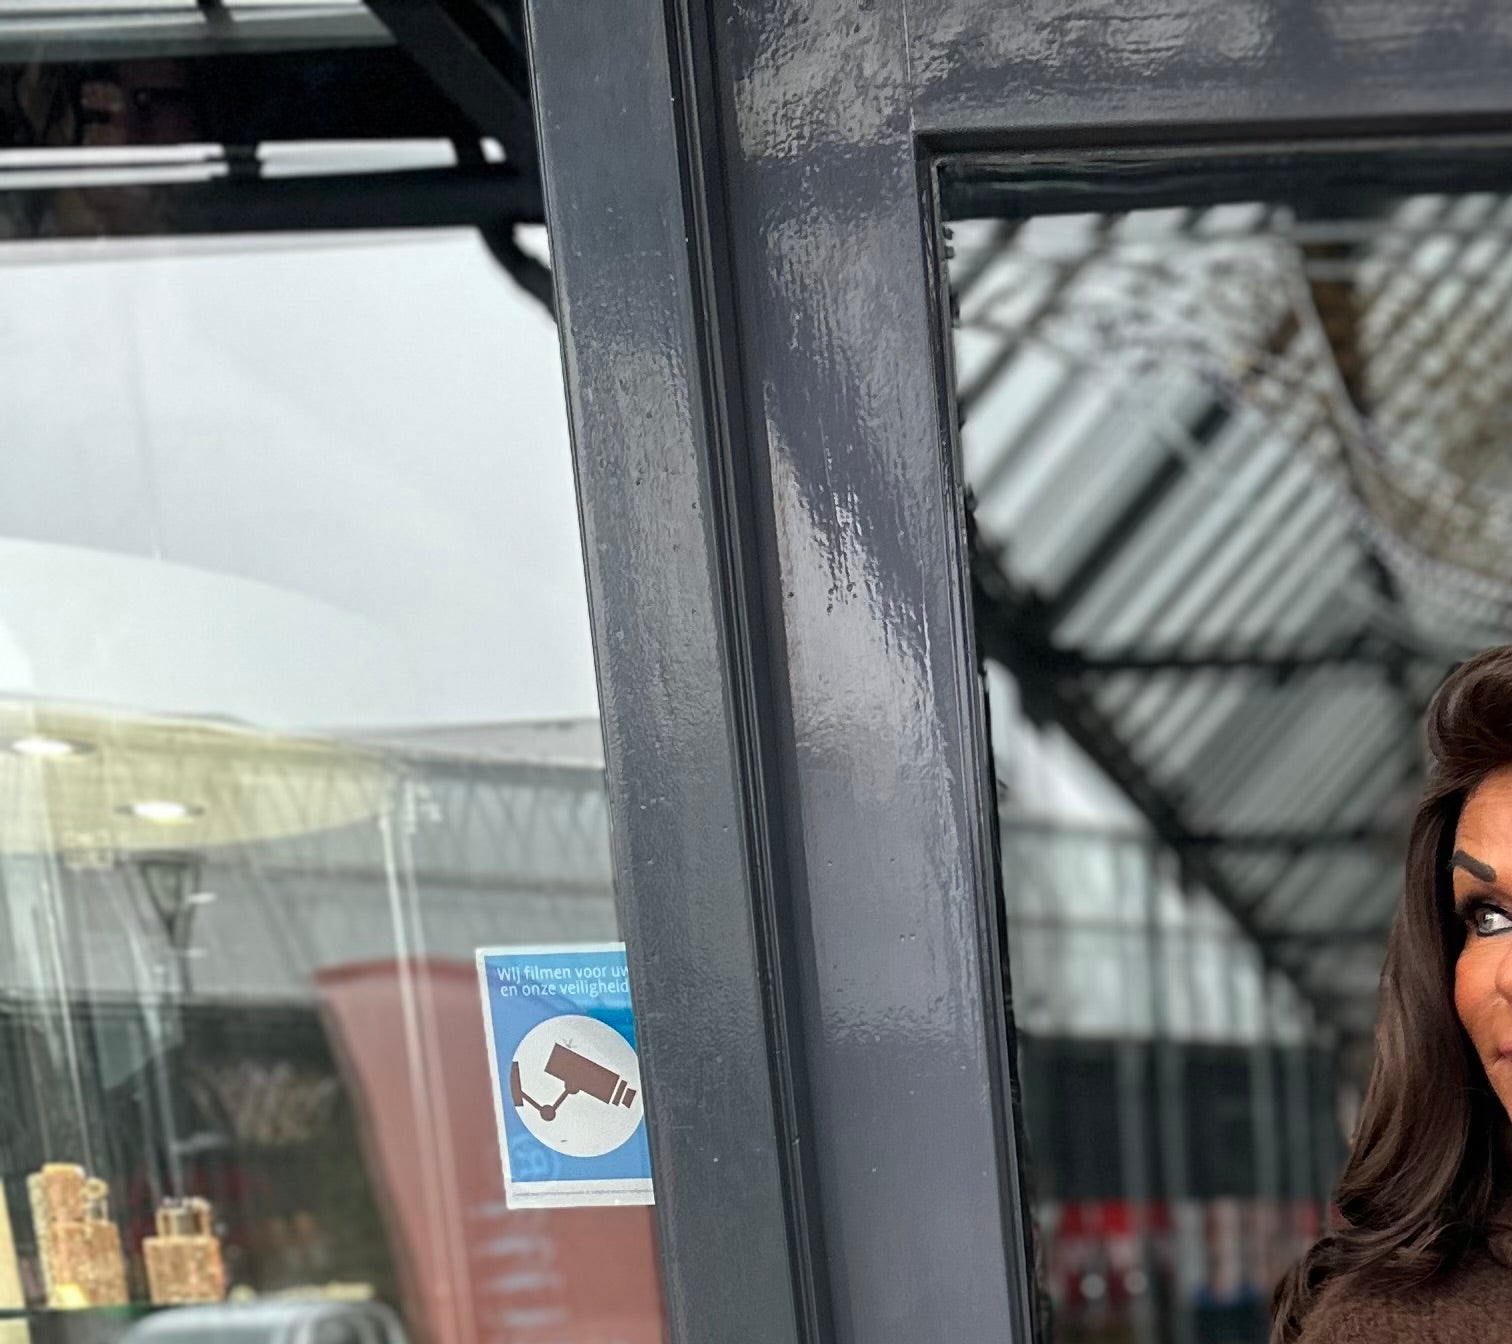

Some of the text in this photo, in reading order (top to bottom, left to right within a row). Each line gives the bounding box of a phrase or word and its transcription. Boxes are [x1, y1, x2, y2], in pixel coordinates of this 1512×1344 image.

[497, 966, 520, 983] Wij
[524, 965, 571, 981] filmen
[574, 966, 606, 979] voor
[501, 979, 629, 998] en onze veiligheid
